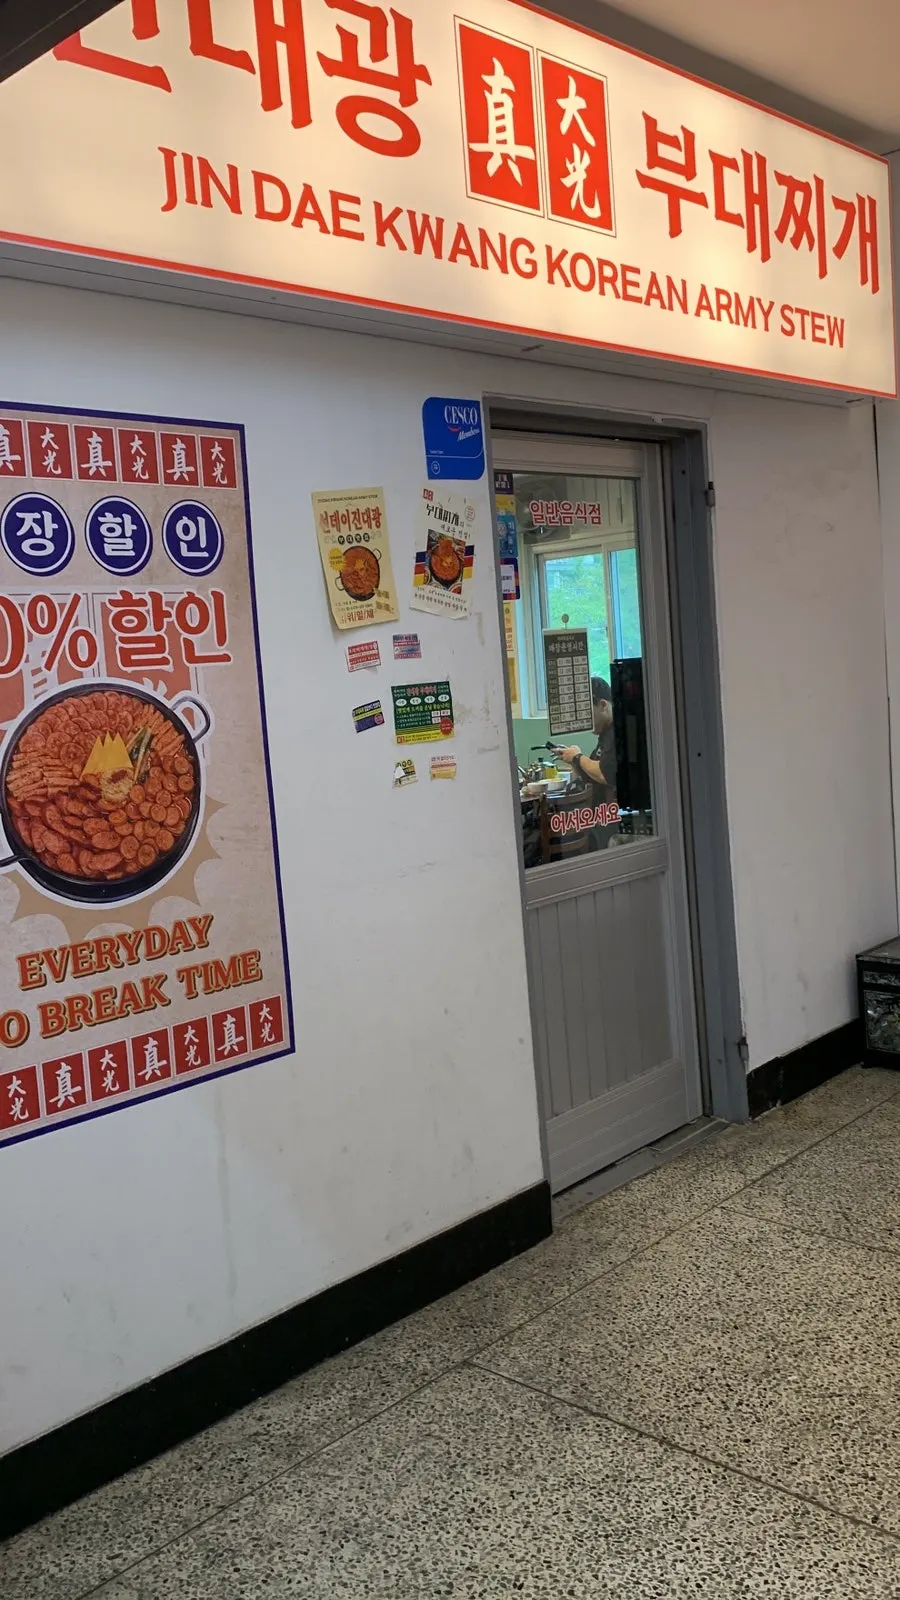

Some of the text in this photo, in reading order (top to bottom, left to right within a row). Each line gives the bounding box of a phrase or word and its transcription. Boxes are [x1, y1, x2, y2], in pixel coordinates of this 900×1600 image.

[469, 56, 536, 187] 真
[635, 110, 880, 295] 부대찌개
[158, 146, 845, 349] JIN DAE KWANG KOREAN ARMY STEW
[444, 405, 478, 425] CESCO
[530, 501, 602, 525] 일반음식점
[108, 590, 232, 669] 할인
[551, 803, 621, 835] 어서오세요
[17, 914, 213, 990] EVERYDAY
[37, 972, 171, 1039] BREAK
[176, 950, 263, 999] TIME
